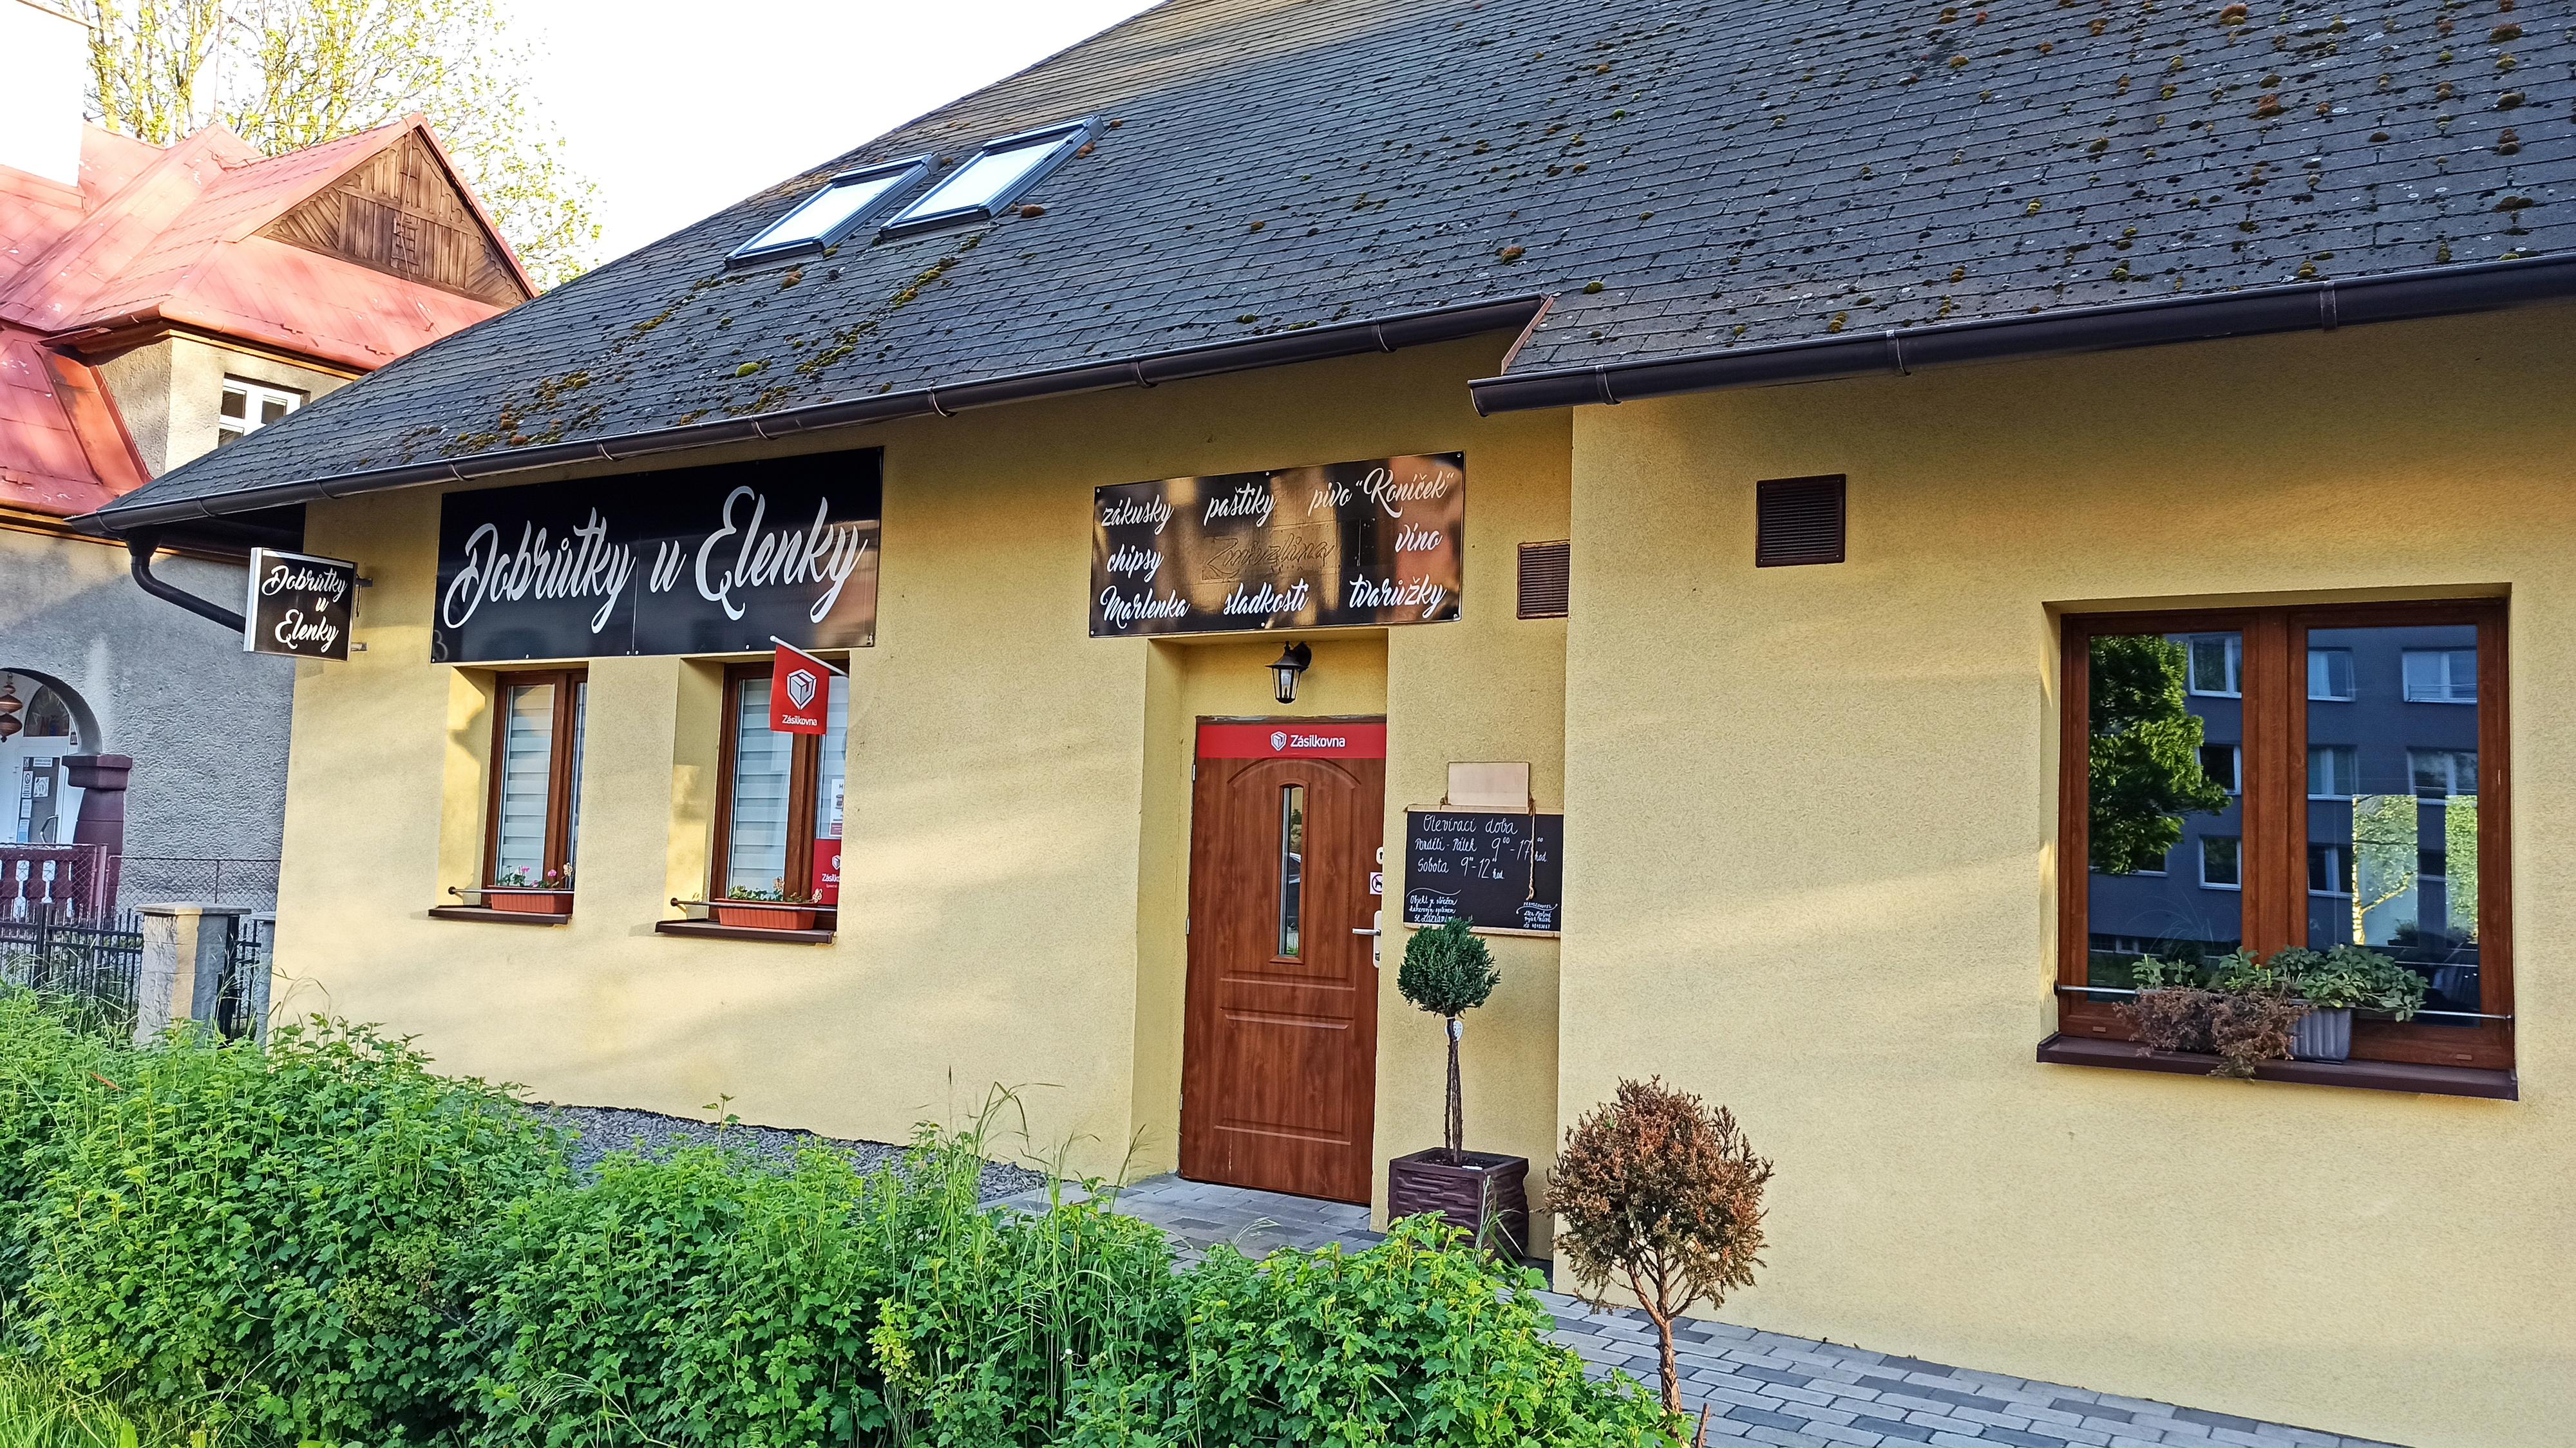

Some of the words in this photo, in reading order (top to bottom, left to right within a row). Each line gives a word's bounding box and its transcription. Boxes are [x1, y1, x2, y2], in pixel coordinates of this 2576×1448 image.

[1101, 495, 1175, 535] zákusky
[1203, 483, 1278, 527] paštiky
[1307, 482, 1352, 516] pivo
[1395, 522, 1443, 553] víno
[444, 507, 634, 634] Dobrůtky
[650, 538, 686, 593] u
[696, 485, 869, 624] Elenky
[1106, 543, 1165, 581] chipsy
[261, 565, 348, 603] Dobrůtky
[1223, 578, 1310, 616] sladkosti
[1349, 573, 1446, 618] tvarůžky
[316, 597, 329, 612] u
[1099, 584, 1191, 629] Marlenka
[274, 608, 339, 653] Elenky
[782, 714, 818, 726] Zásilkovna
[1290, 734, 1346, 748] Zásilkovna
[1485, 818, 1518, 834] doba
[1453, 837, 1477, 852] Pátek
[822, 873, 840, 882] Zásilko
[1417, 857, 1450, 873] Sobota
